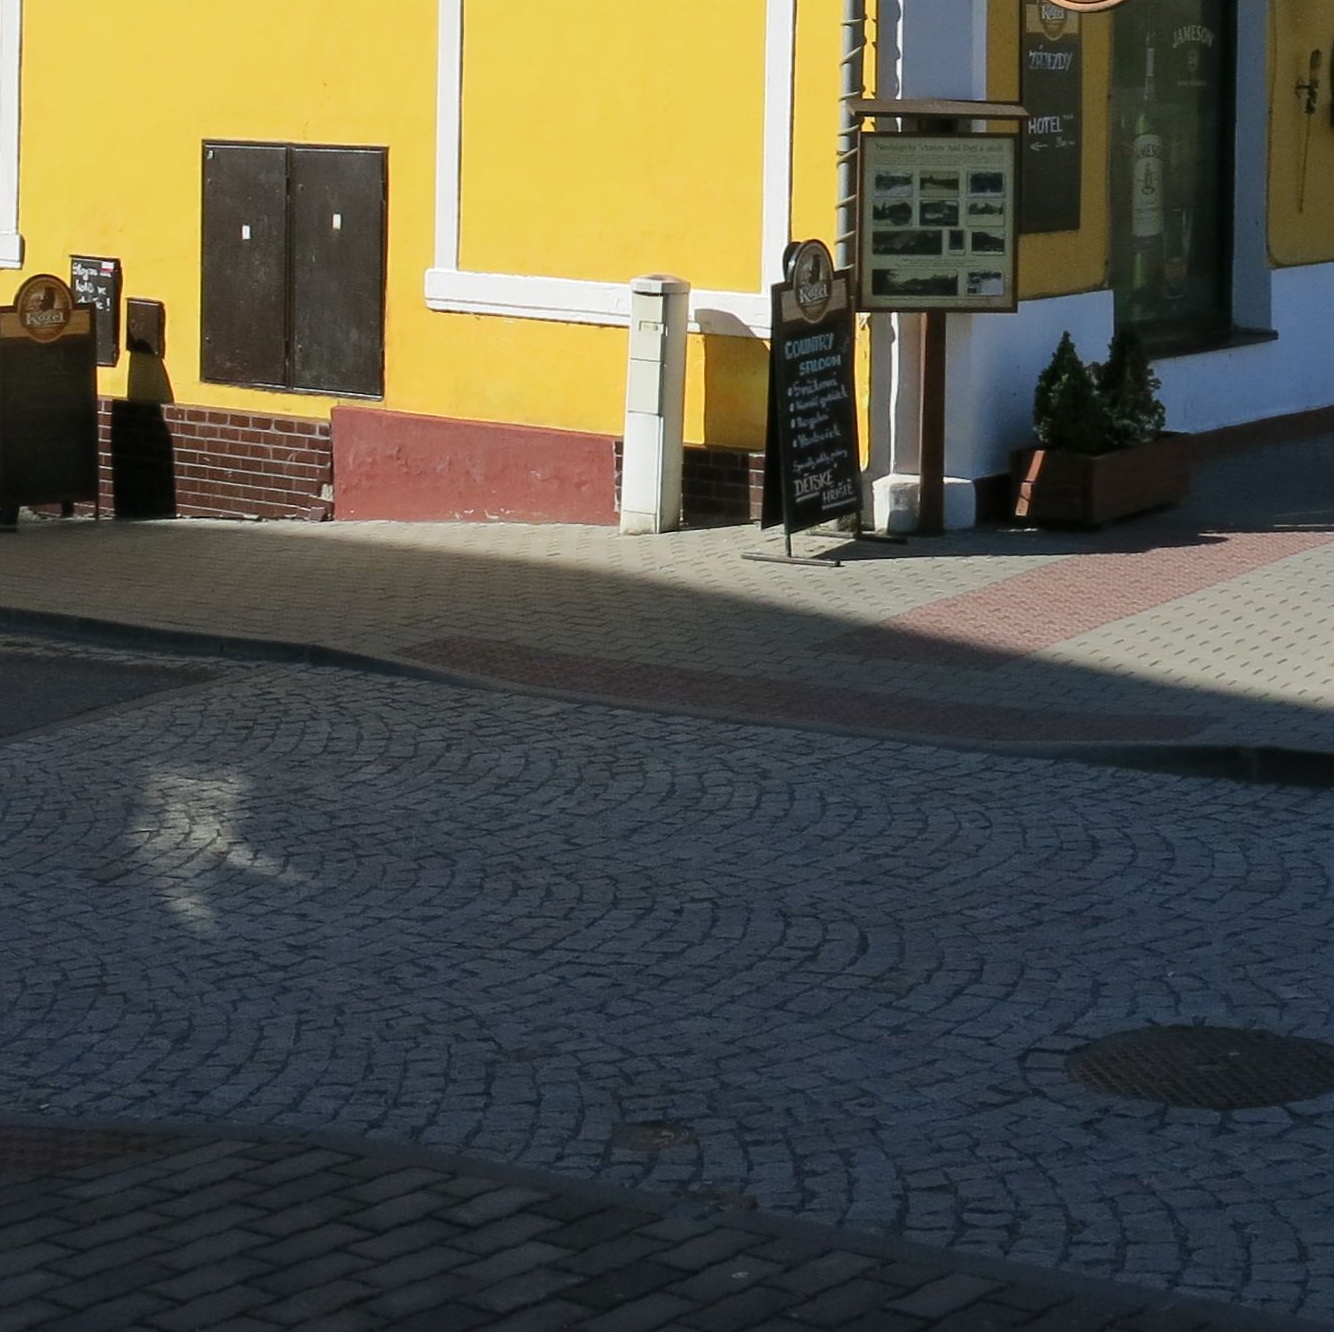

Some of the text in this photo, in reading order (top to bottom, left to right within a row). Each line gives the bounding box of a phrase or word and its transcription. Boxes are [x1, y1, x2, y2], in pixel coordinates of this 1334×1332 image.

[1172, 25, 1214, 48] JAMESON
[1028, 116, 1063, 134] HOTEL
[26, 311, 67, 325] Kozel
